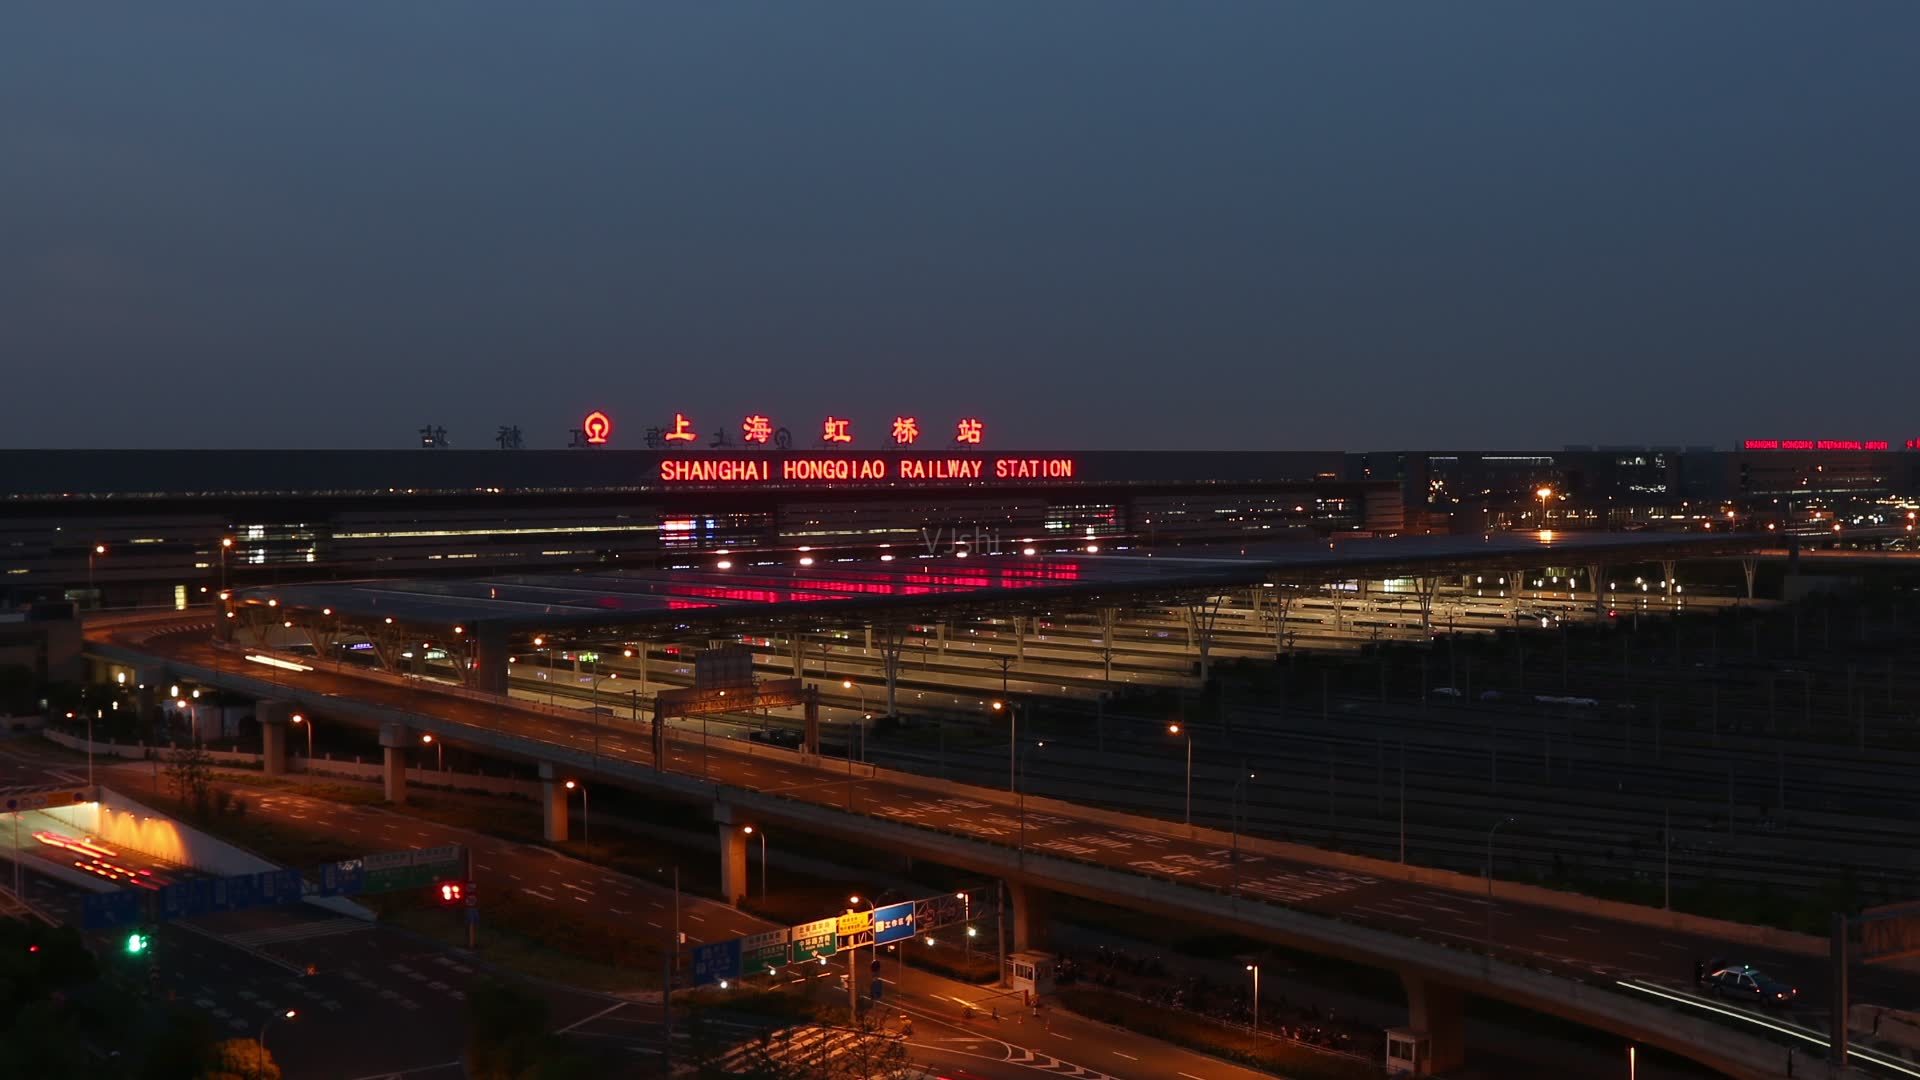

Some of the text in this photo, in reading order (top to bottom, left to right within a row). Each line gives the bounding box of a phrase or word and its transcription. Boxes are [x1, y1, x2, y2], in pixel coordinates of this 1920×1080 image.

[664, 412, 984, 445] 上海虹桥站
[660, 459, 1073, 482] SHANGHAI HONGQIAO RAILWAY STATION
